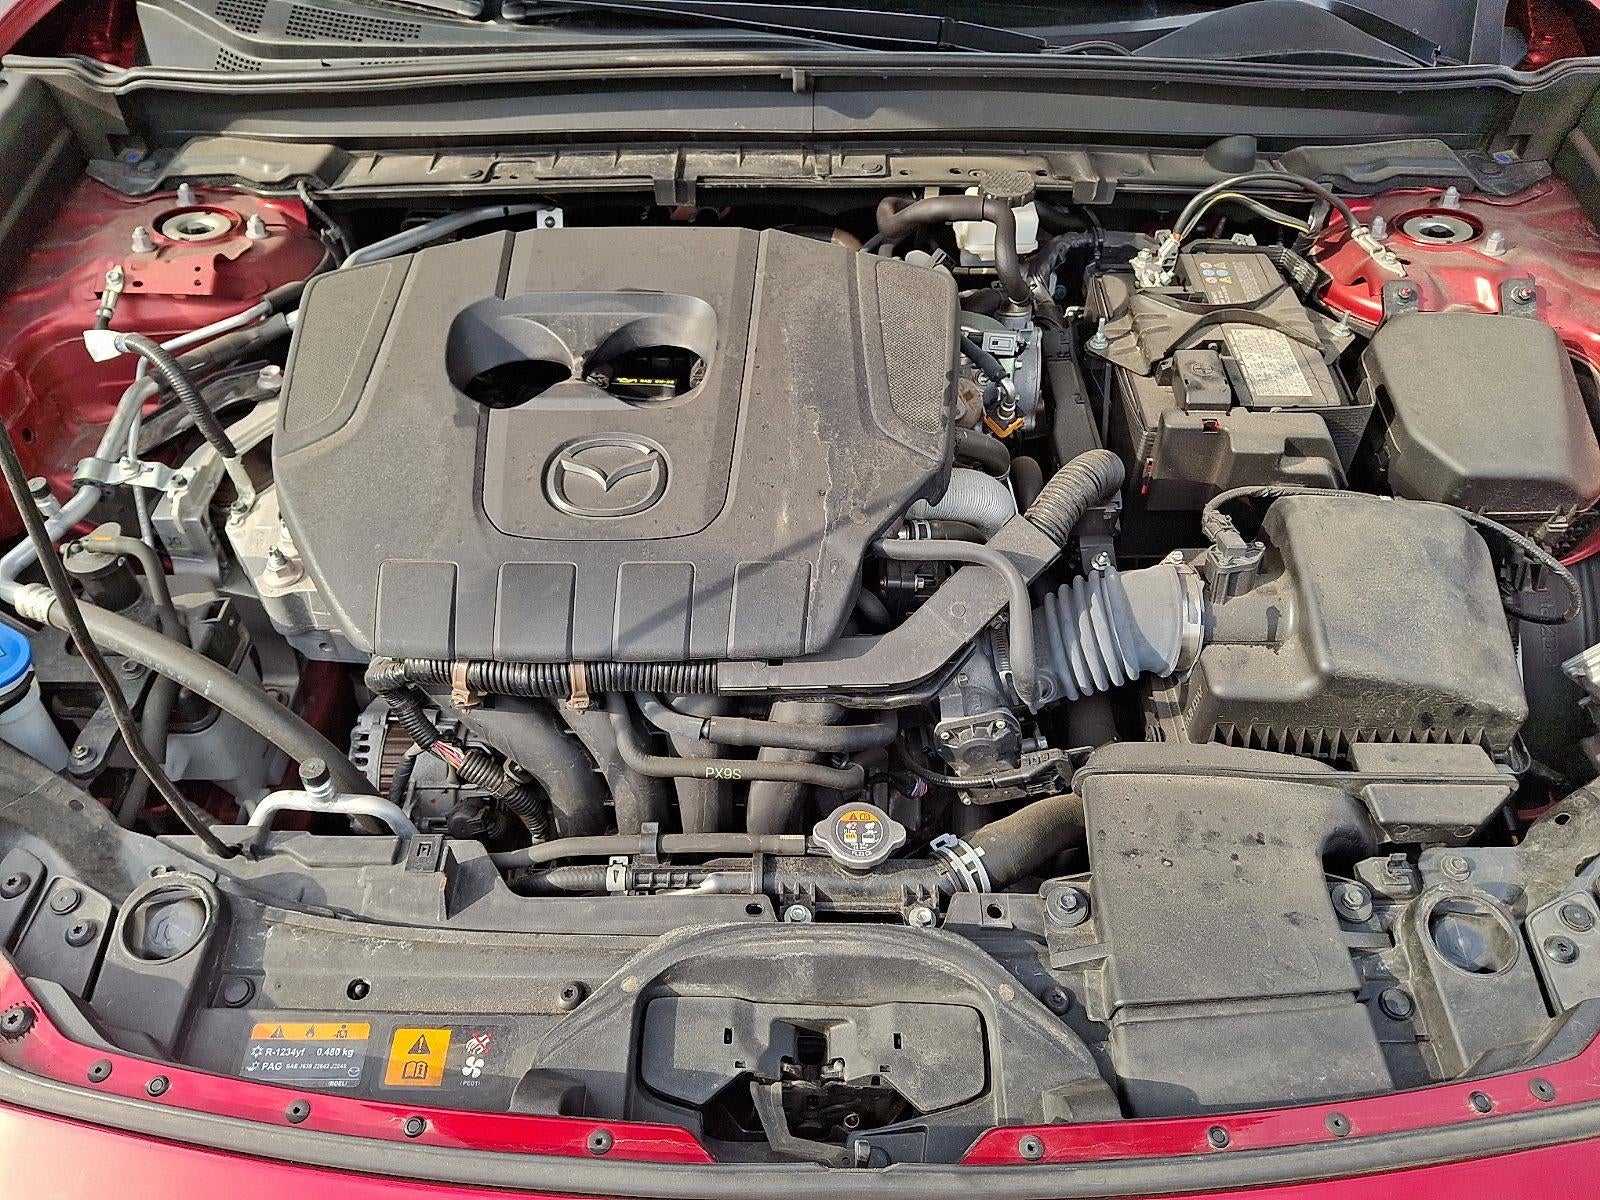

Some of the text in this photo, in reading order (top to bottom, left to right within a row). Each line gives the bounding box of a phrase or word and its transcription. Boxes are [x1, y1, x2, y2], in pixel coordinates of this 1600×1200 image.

[705, 767, 742, 779] PX9S
[265, 1048, 305, 1057] R-1234yf
[342, 1048, 354, 1057] kg
[262, 1062, 282, 1070] PAG
